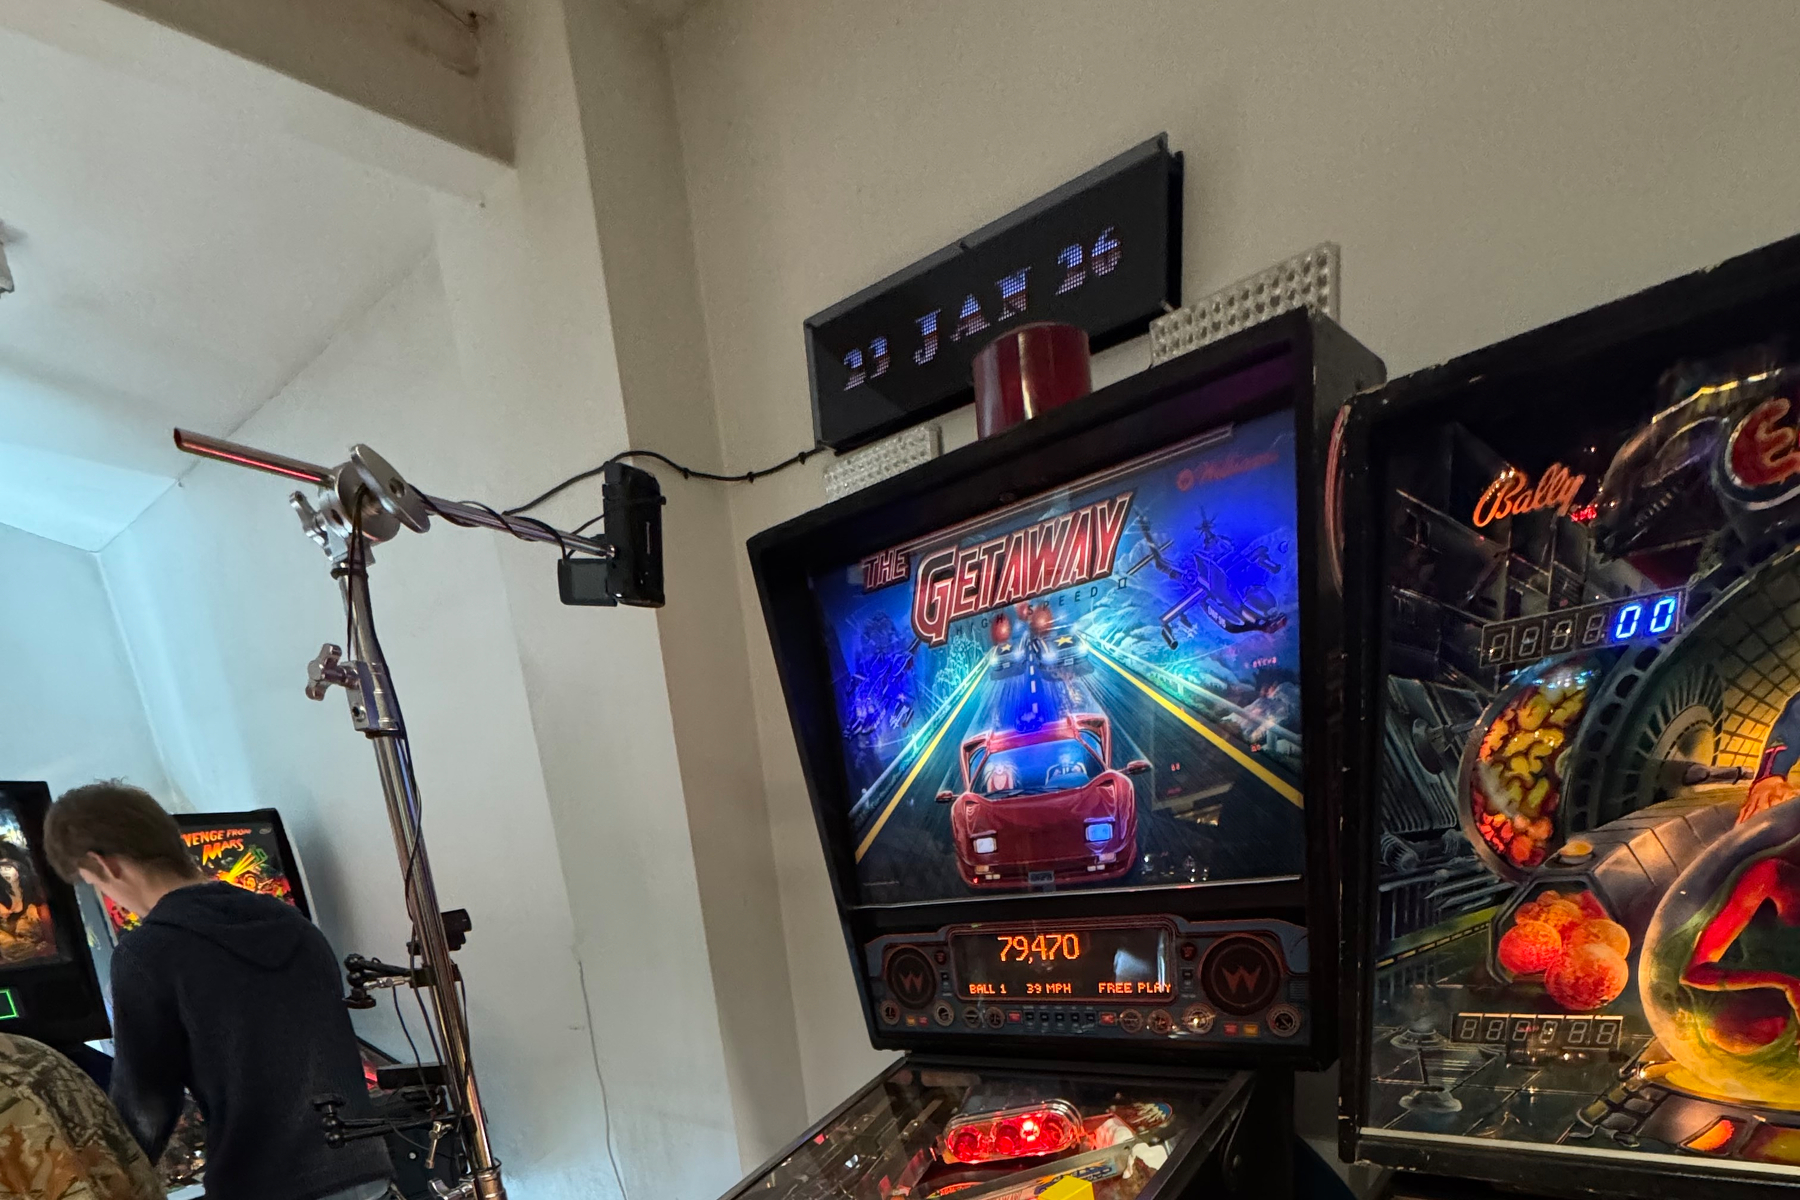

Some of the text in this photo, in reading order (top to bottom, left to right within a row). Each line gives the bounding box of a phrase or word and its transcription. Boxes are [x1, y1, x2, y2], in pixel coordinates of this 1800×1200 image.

[913, 266, 1032, 366] JAN
[1055, 226, 1121, 296] 26
[1473, 463, 1587, 527] Bally
[861, 488, 1136, 647] THE GETAWAY
[181, 829, 226, 848] VENGE
[202, 838, 245, 866] MARS
[997, 933, 1080, 965] 79,470
[969, 982, 1172, 995] BALL 1 39 MPH FREE PLAY
